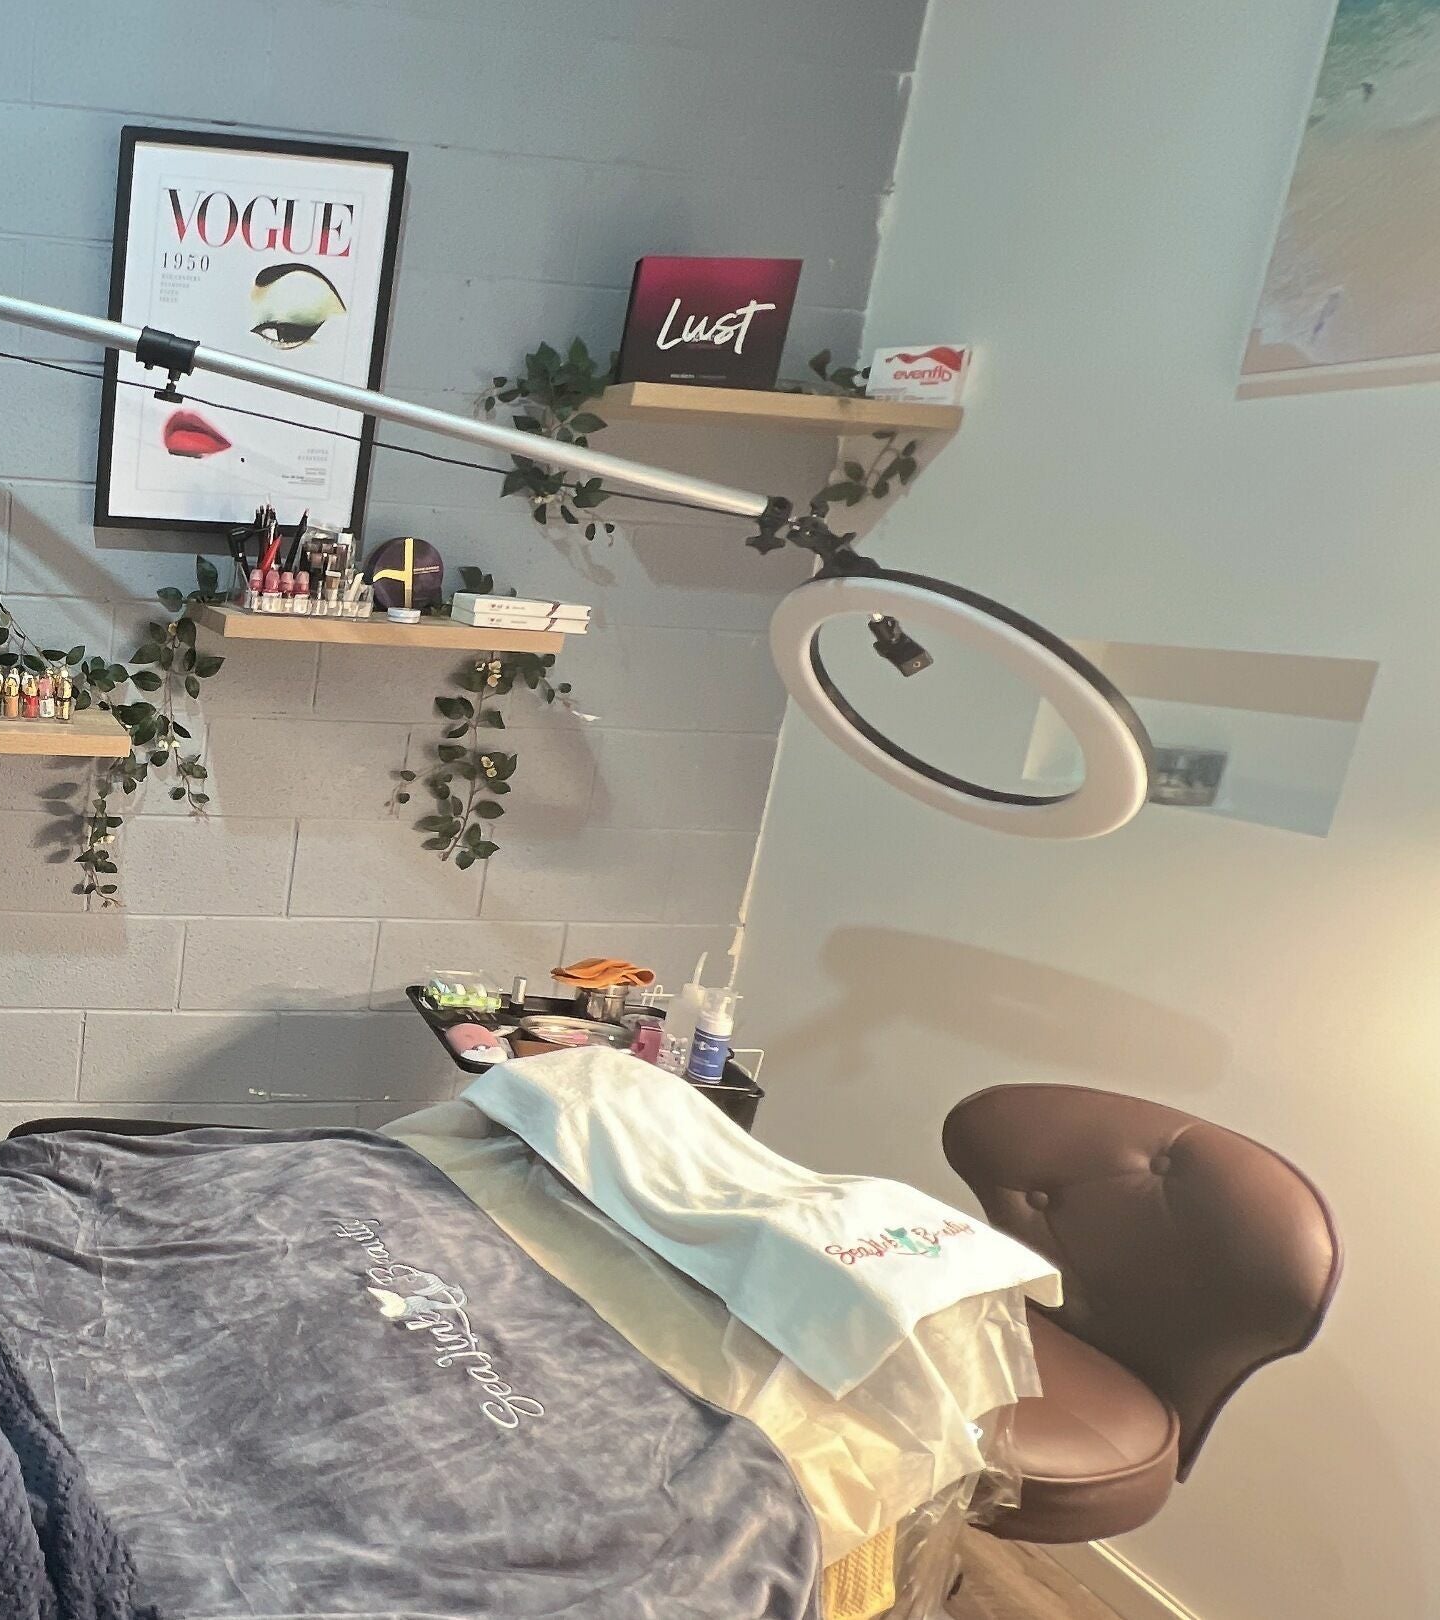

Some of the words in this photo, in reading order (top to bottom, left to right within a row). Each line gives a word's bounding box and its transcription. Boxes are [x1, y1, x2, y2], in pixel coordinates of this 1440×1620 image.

[163, 188, 354, 257] VOGUE
[162, 252, 210, 272] 1950
[657, 298, 776, 355] Lust
